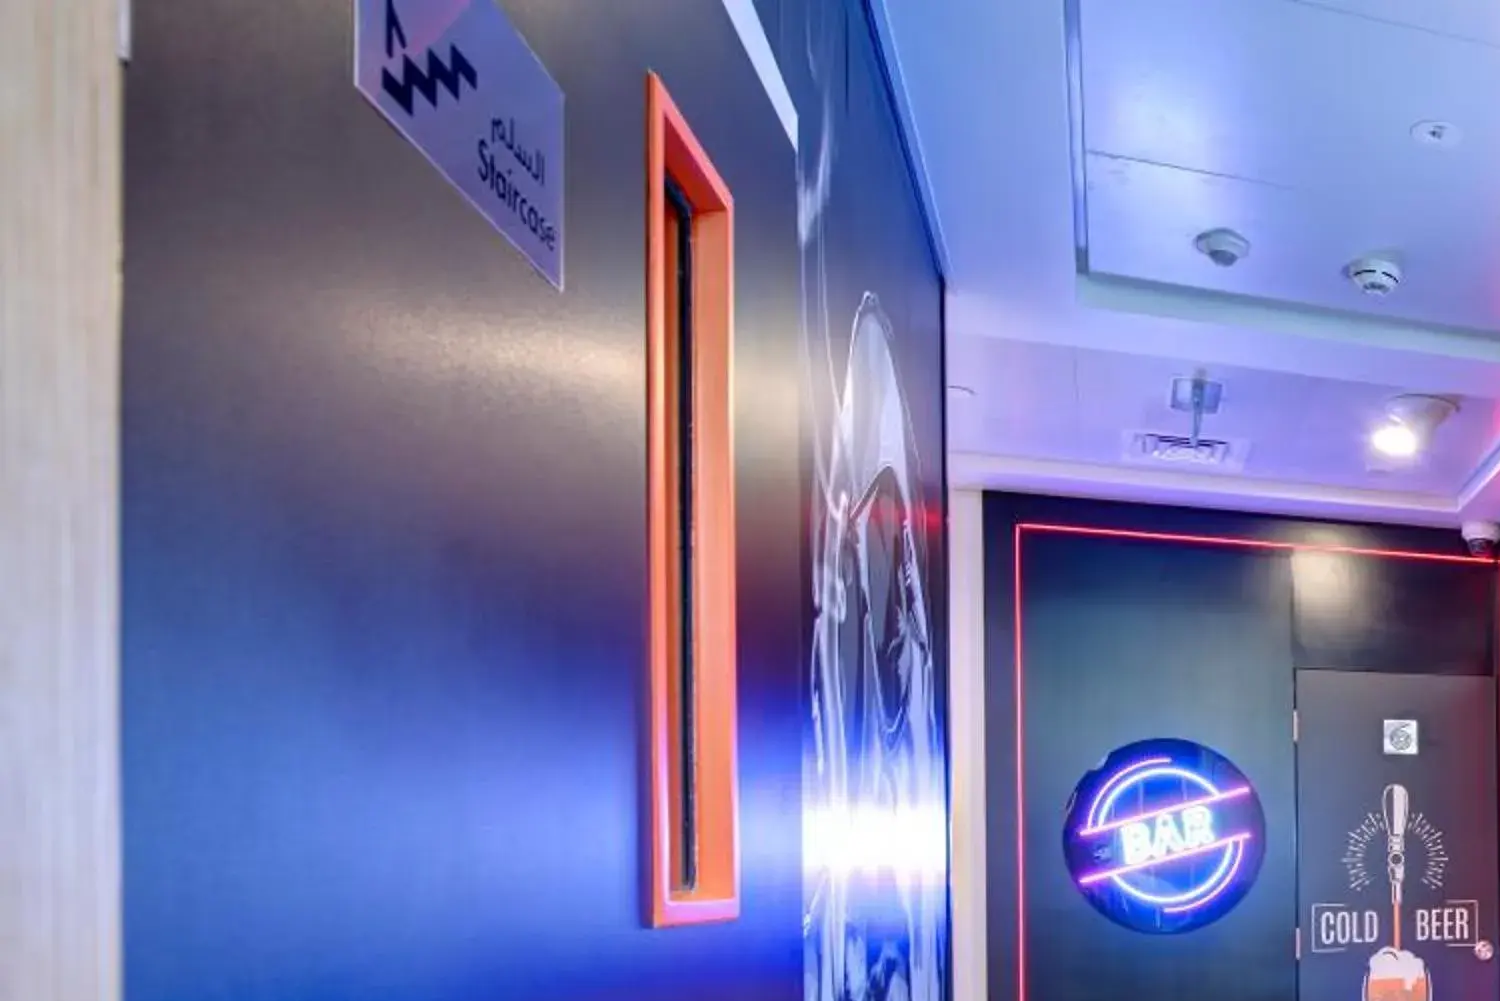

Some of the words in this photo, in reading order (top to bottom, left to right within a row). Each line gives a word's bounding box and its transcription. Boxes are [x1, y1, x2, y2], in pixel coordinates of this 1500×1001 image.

[491, 117, 546, 187] السلم
[477, 138, 557, 252] Staircase
[1119, 804, 1217, 866] BAR
[1320, 910, 1379, 945] COLD
[1416, 908, 1470, 941] BEER
